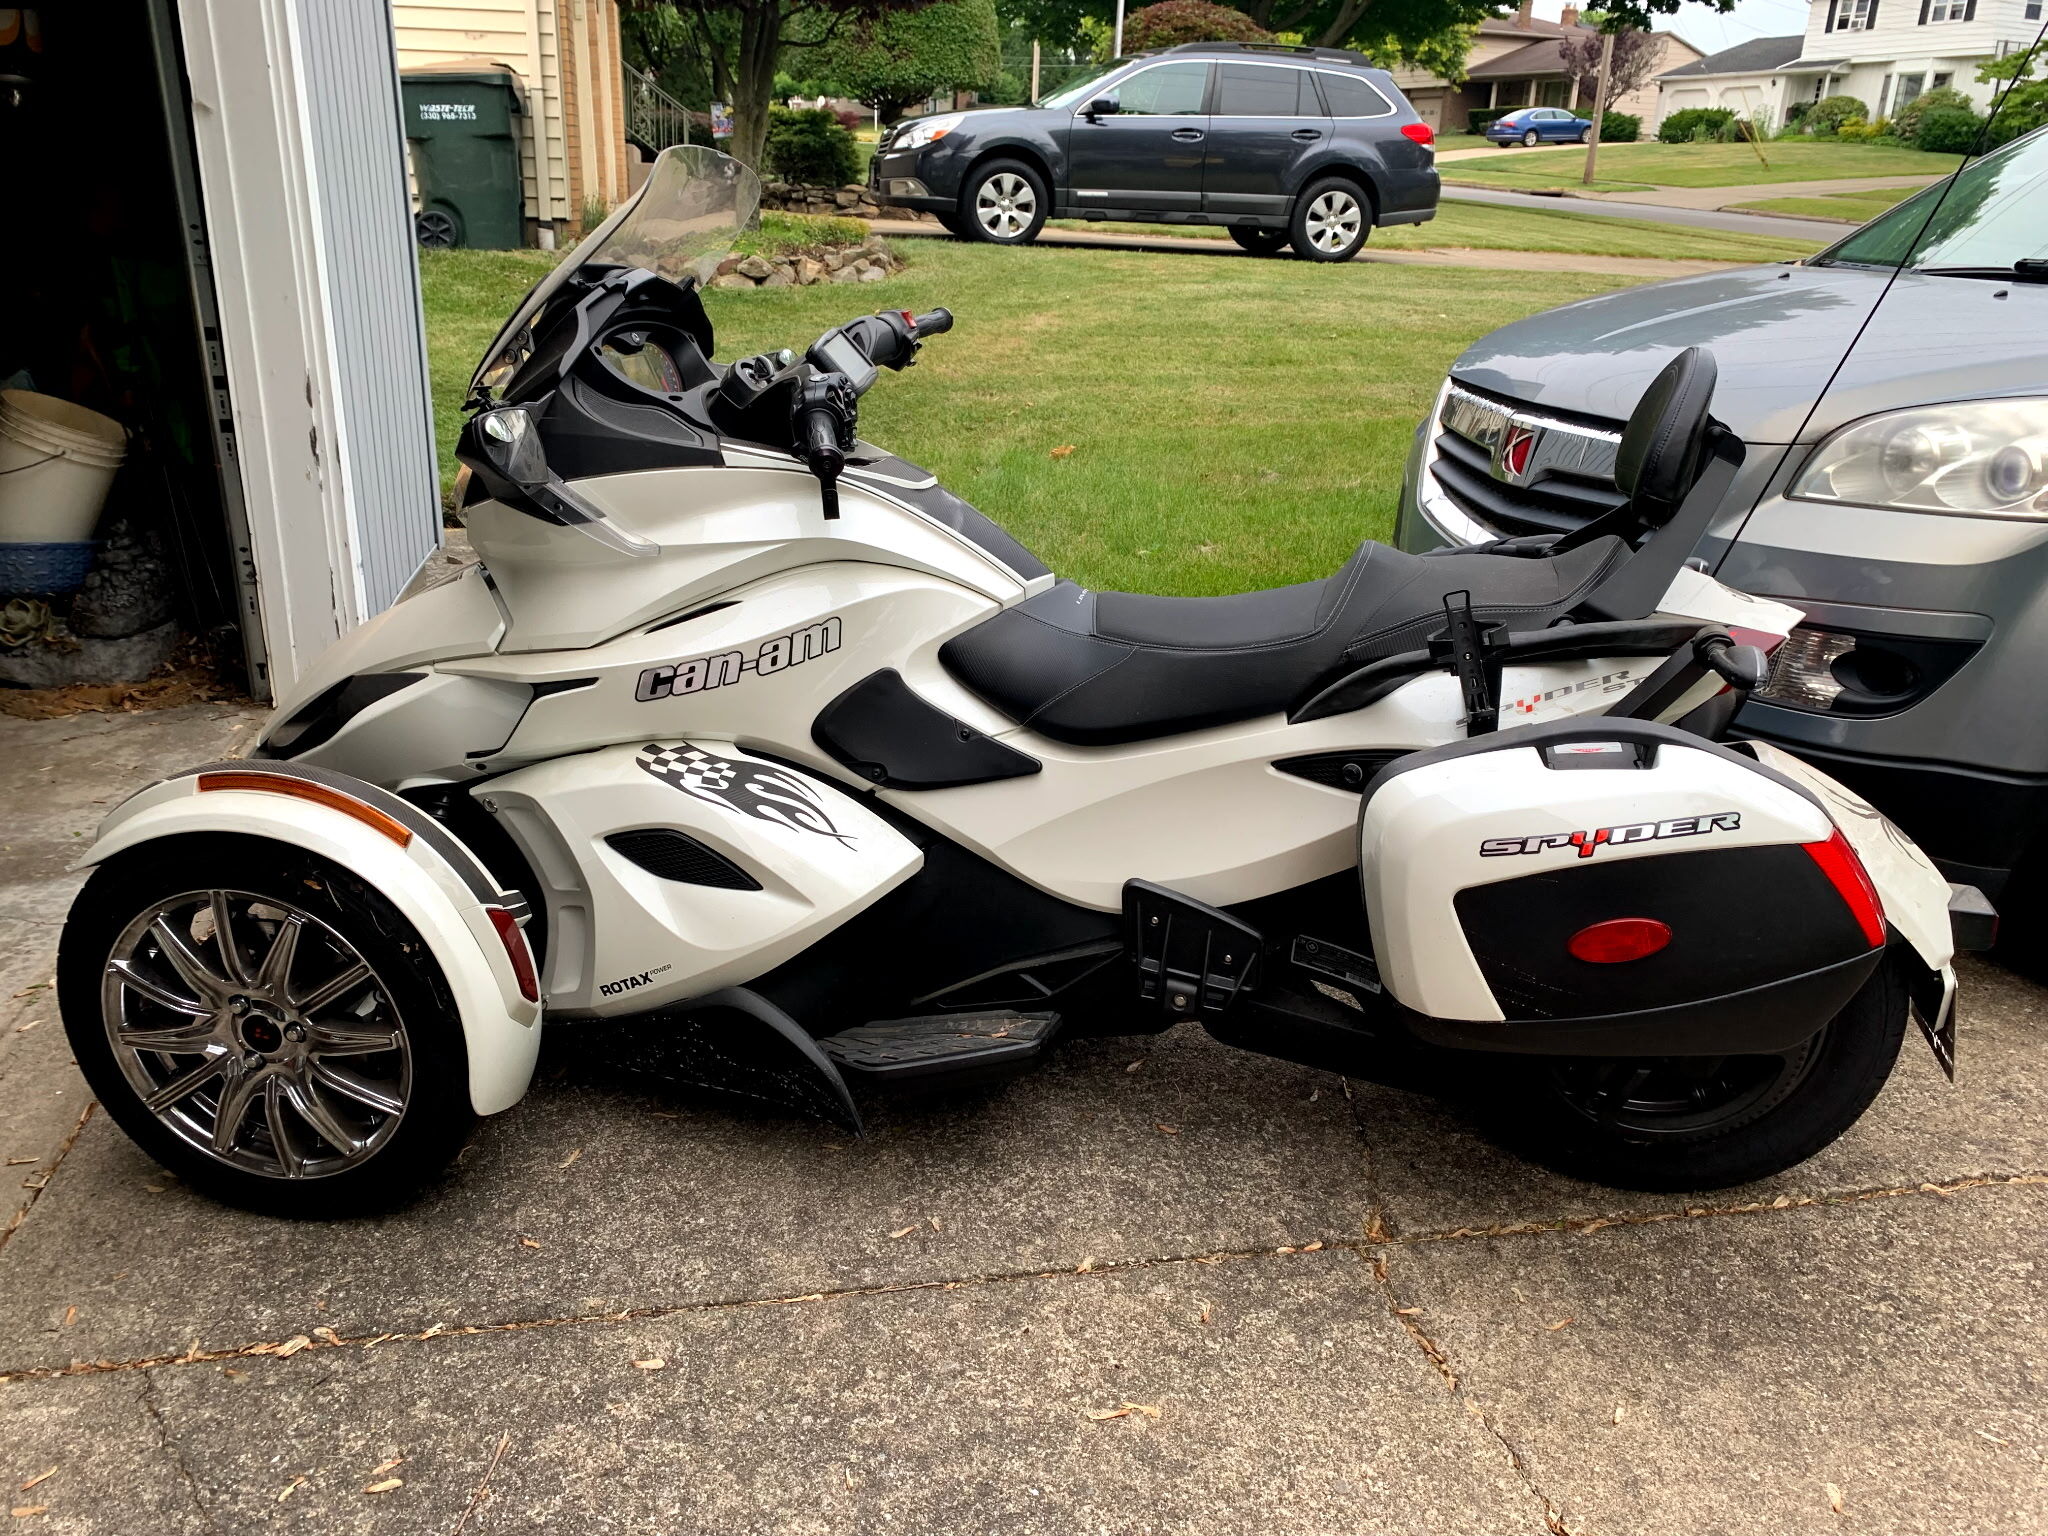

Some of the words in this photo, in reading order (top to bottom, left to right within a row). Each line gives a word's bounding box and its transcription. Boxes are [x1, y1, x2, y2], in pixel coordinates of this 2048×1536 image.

[635, 616, 842, 702] can-am
[1480, 812, 1741, 857] SPYDER
[599, 971, 654, 996] ROTAX
[649, 963, 672, 976] POWER
